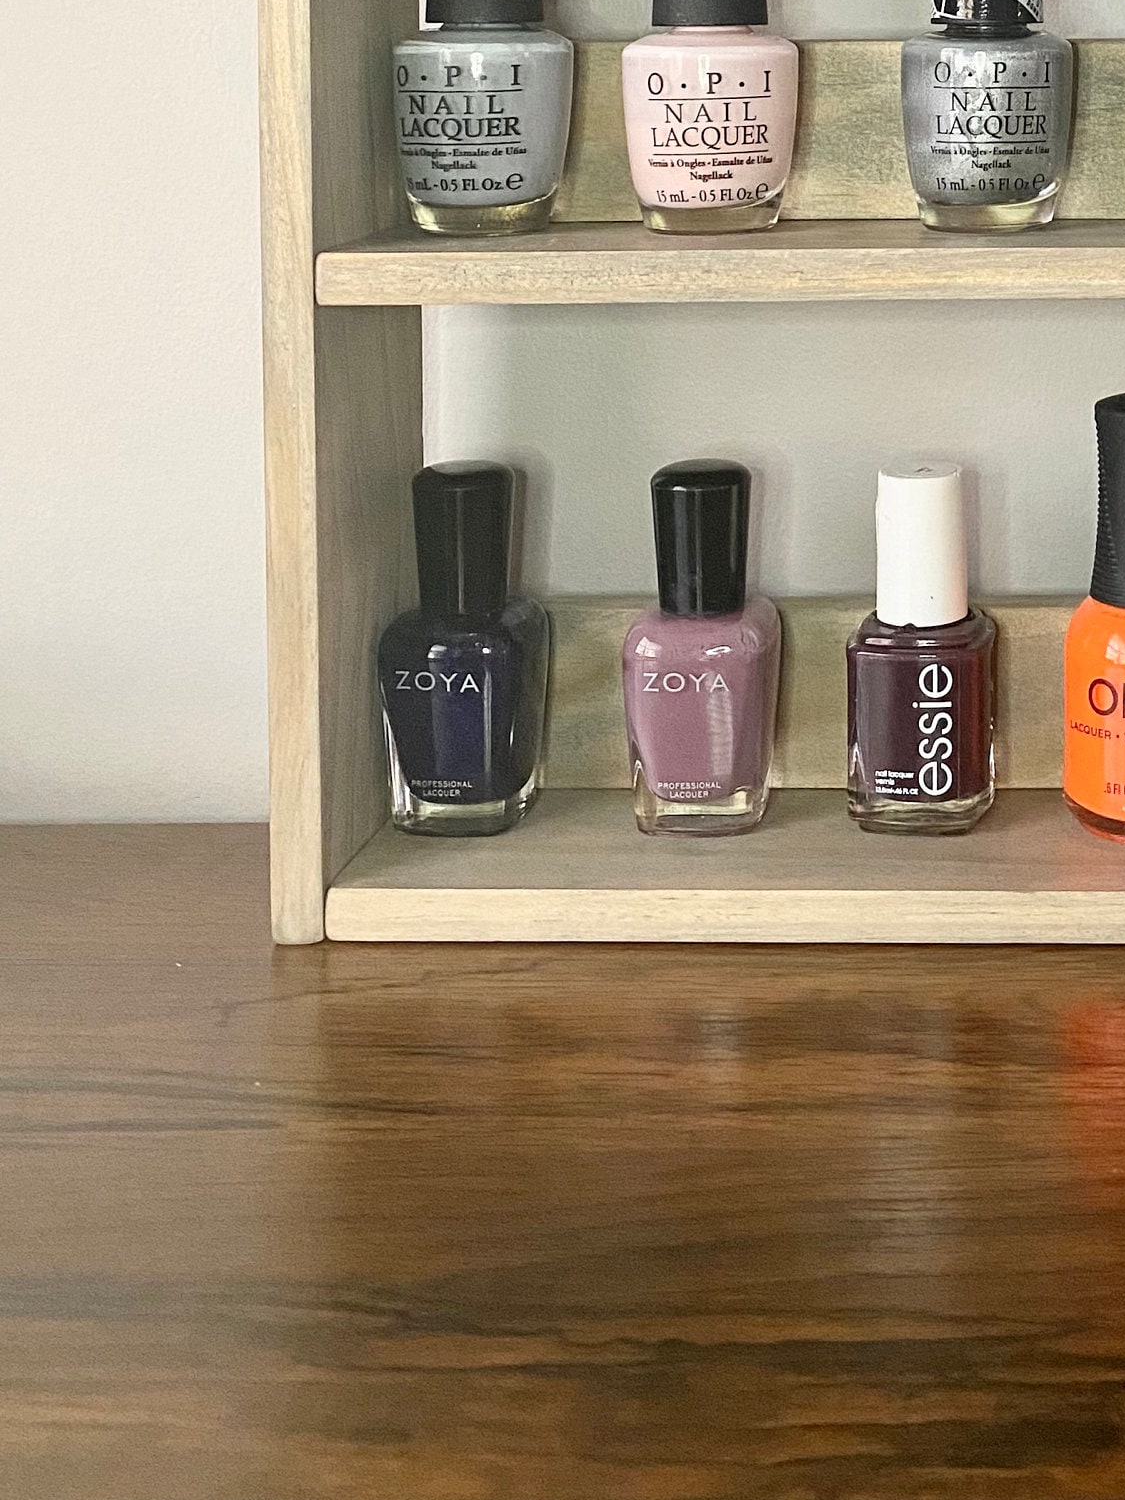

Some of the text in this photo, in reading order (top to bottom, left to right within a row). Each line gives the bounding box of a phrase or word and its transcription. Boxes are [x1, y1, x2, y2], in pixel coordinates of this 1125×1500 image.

[409, 95, 505, 116] NAIL
[951, 92, 1036, 111] NAIL
[665, 101, 757, 123] NAIL
[400, 116, 522, 141] LACQUER
[936, 115, 1046, 139] LACQUER
[651, 124, 769, 150] LACQUER
[491, 148, 503, 156] de
[1024, 146, 1033, 155] de
[431, 160, 476, 172] Nagellack
[677, 158, 706, 169] Ongles
[746, 156, 755, 165] de
[971, 160, 1012, 171] Nagellack
[690, 170, 733, 183] Nagellack
[936, 177, 947, 190] 15
[950, 179, 968, 191] mL
[657, 189, 667, 203] 15
[670, 190, 689, 203] mL
[395, 670, 480, 693] ZOYA
[643, 672, 730, 693] ZOYA
[911, 663, 953, 796] essie
[1070, 719, 1112, 740] LACQUER
[411, 779, 473, 788] PROFESSIONAL
[657, 781, 721, 790] PROFESSIONAL
[422, 789, 461, 797] LACQUER
[669, 790, 709, 798] LACQUER
